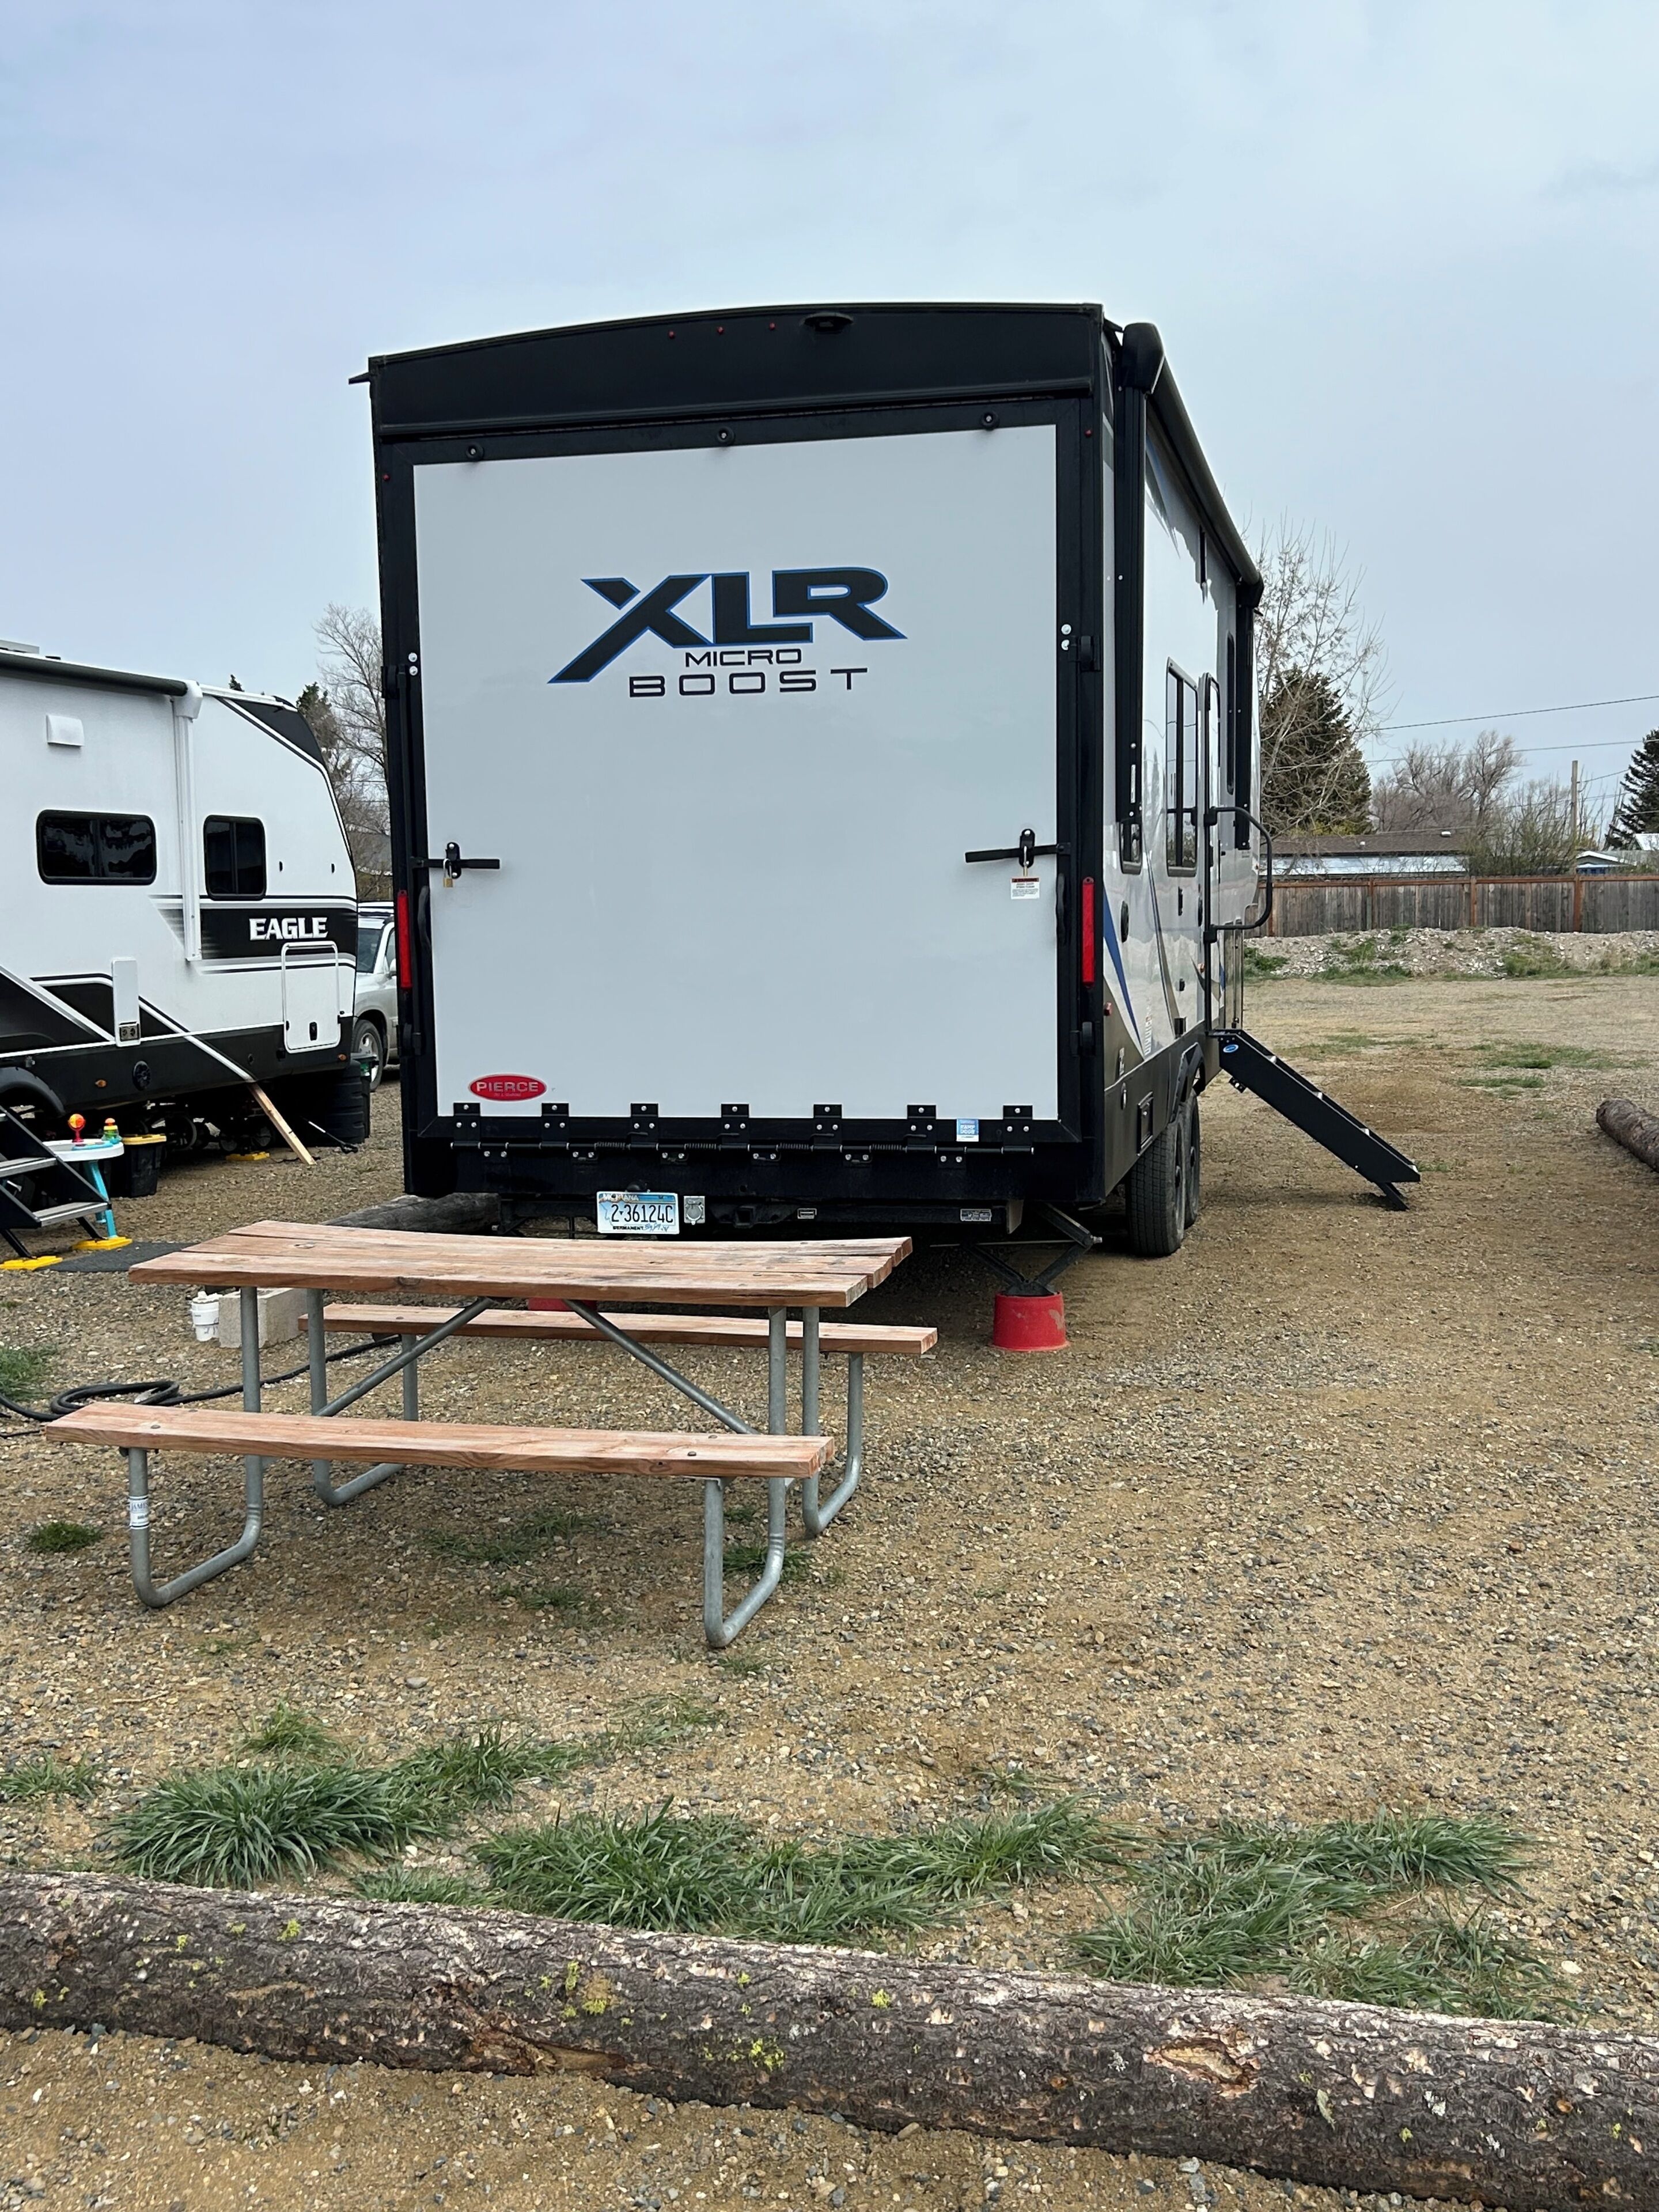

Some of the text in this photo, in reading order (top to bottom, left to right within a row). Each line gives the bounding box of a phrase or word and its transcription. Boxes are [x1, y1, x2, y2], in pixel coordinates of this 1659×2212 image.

[547, 566, 908, 684] XLR
[685, 648, 802, 668] MICRO
[629, 667, 868, 698] BOOST
[249, 917, 328, 940] EAGLE
[476, 1081, 539, 1093] PIERCE
